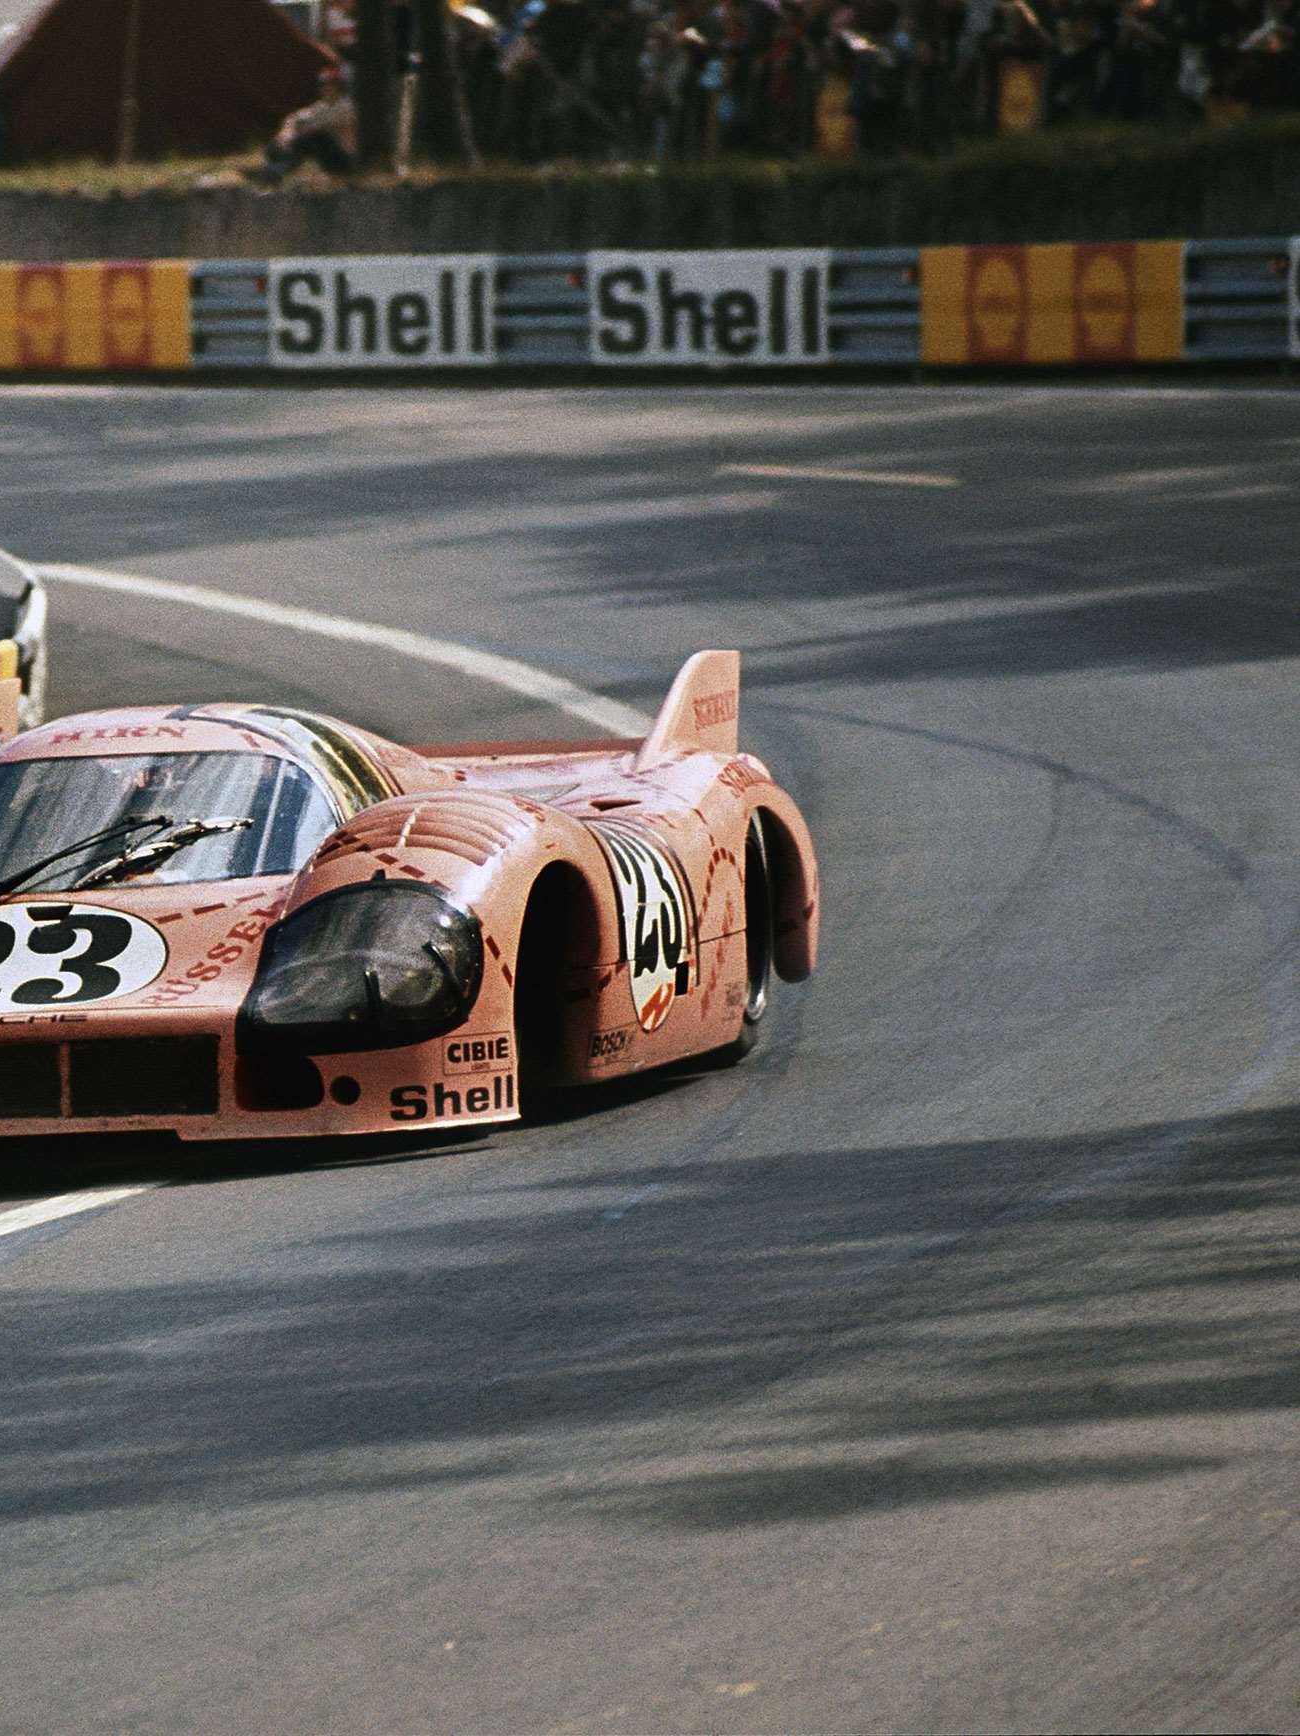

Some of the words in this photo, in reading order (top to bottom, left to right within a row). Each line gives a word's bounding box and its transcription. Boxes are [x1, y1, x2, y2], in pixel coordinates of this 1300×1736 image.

[279, 269, 485, 354] Shell
[599, 266, 818, 354] Shell
[389, 1073, 514, 1121] Shell
